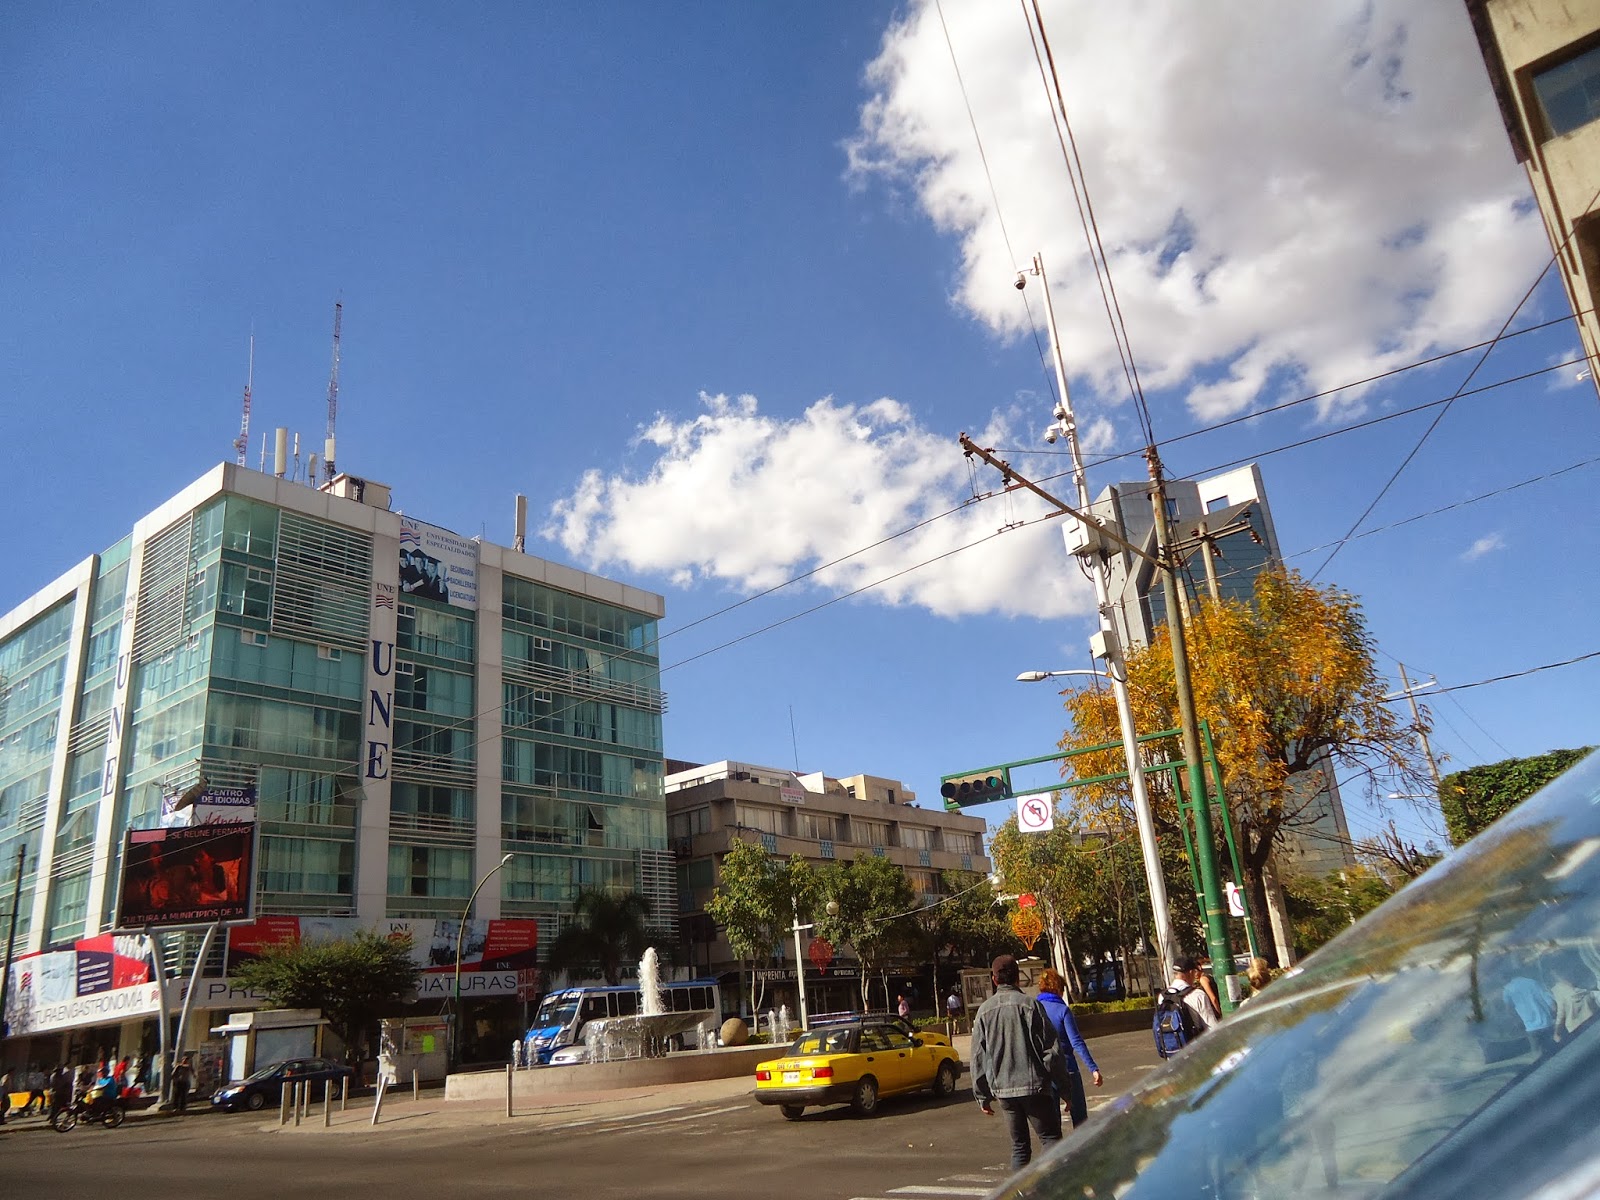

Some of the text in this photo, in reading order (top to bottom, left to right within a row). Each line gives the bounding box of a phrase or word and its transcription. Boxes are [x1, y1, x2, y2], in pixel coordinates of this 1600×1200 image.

[401, 519, 419, 531] UNE
[426, 531, 467, 549] UNIVERSIDAD
[426, 540, 476, 558] ESPECIALIDADES
[376, 582, 395, 594] UNE
[365, 639, 394, 780] UNE
[103, 652, 131, 798] UNE
[208, 789, 243, 797] CENTRO
[201, 795, 251, 805] DE IDIOMAS
[184, 829, 210, 838] REUNE
[169, 908, 218, 919] MUNICIPIOS
[221, 908, 231, 916] DE
[414, 974, 516, 993] CIATURAS
